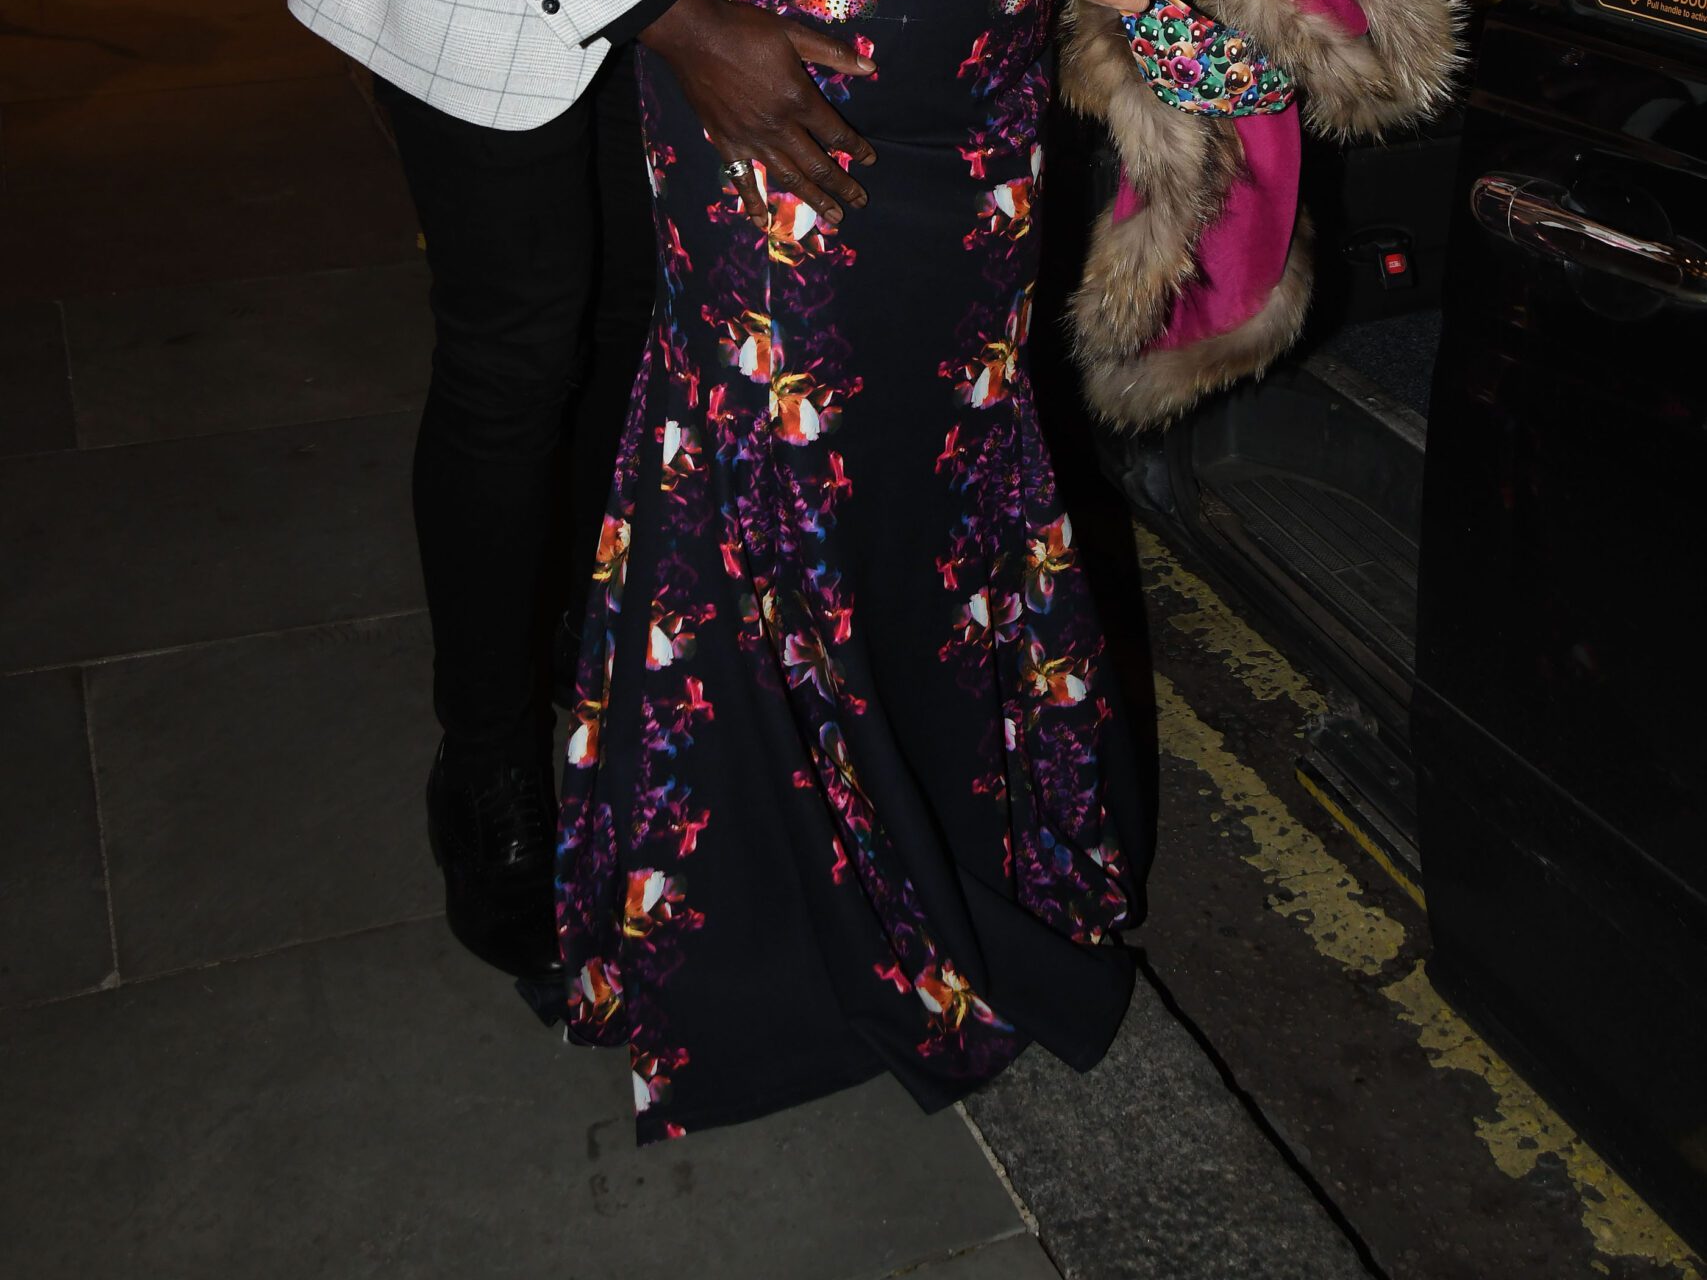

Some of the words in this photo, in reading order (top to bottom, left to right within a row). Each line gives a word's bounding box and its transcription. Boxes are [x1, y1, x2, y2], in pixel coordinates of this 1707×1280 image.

[1660, 1, 1682, 16] handle
[1683, 9, 1690, 17] to
[1691, 12, 1707, 23] activ
